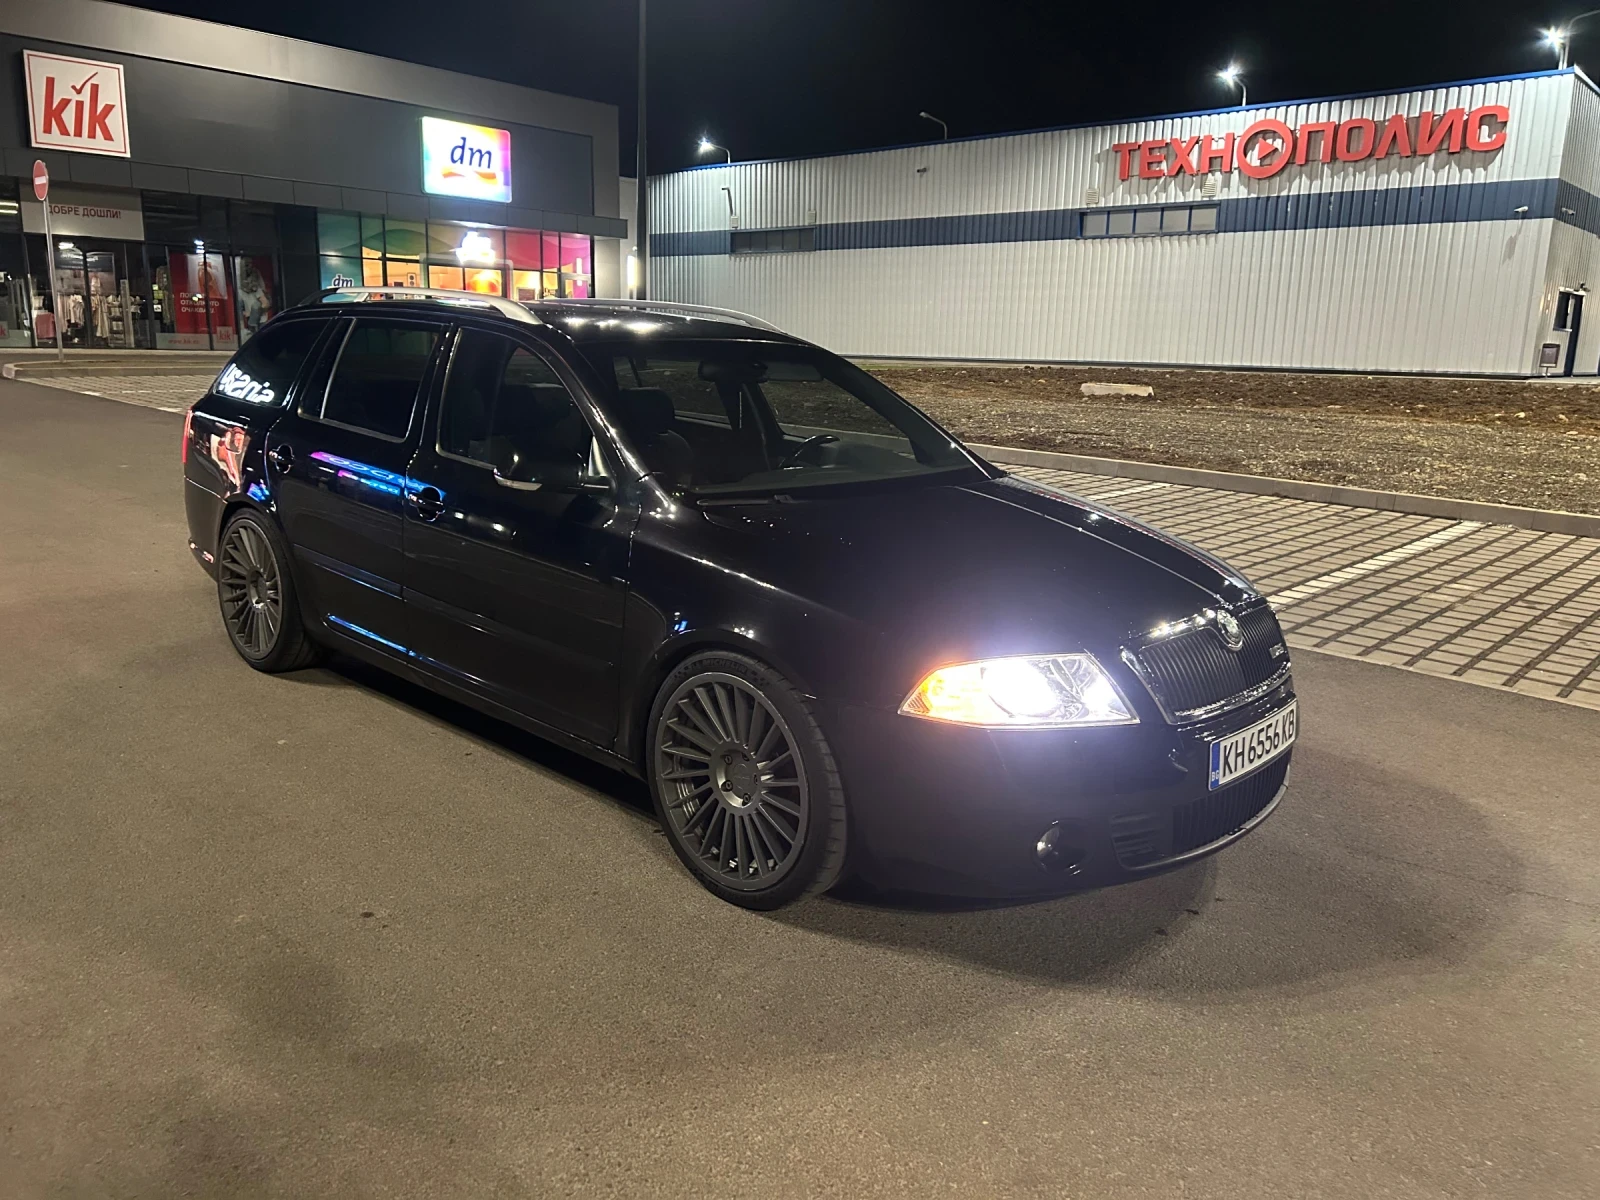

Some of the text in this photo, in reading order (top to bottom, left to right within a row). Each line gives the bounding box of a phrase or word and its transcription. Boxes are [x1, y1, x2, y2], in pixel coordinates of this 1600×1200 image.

[450, 136, 492, 169] dm
[1112, 105, 1510, 181] ТЕХНОПОЛИС
[82, 207, 122, 219] ДОШЛИ!
[332, 274, 354, 287] dm
[1248, 719, 1280, 764] 6556
